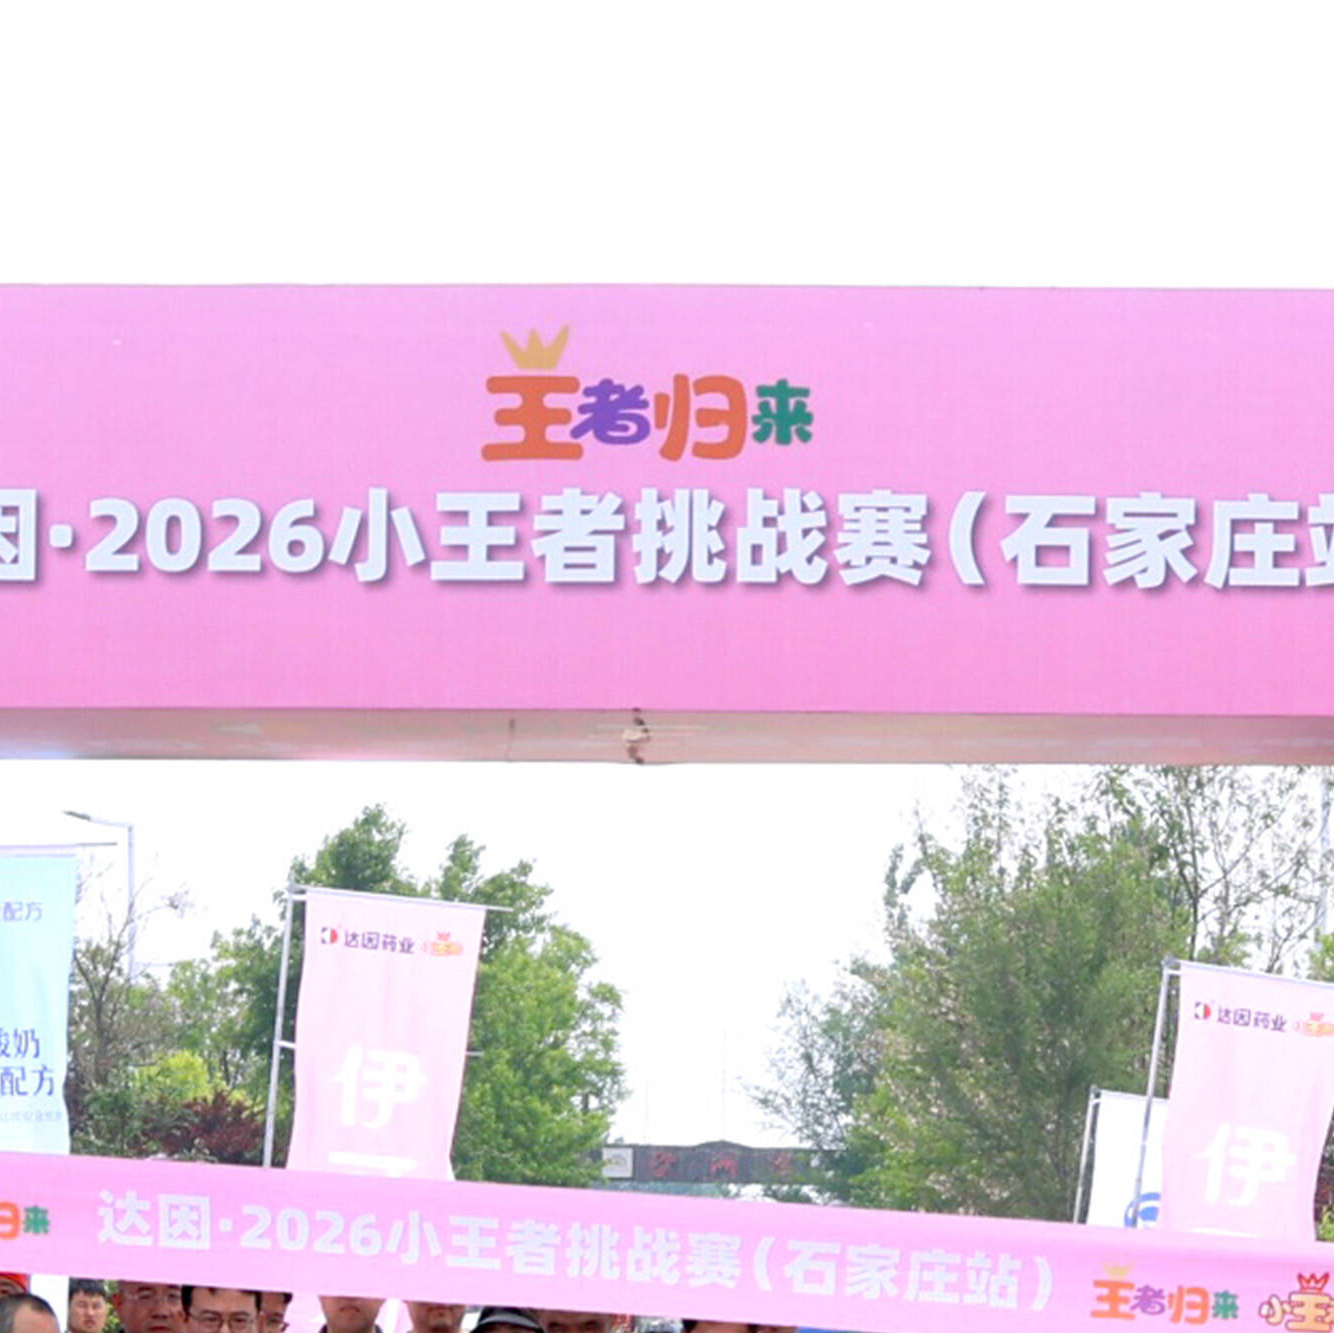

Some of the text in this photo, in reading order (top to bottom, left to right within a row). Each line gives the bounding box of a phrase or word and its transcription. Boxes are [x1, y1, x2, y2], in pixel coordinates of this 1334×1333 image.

[481, 374, 812, 461] 王者归来
[1091, 1278, 1239, 1327] 王者归来
